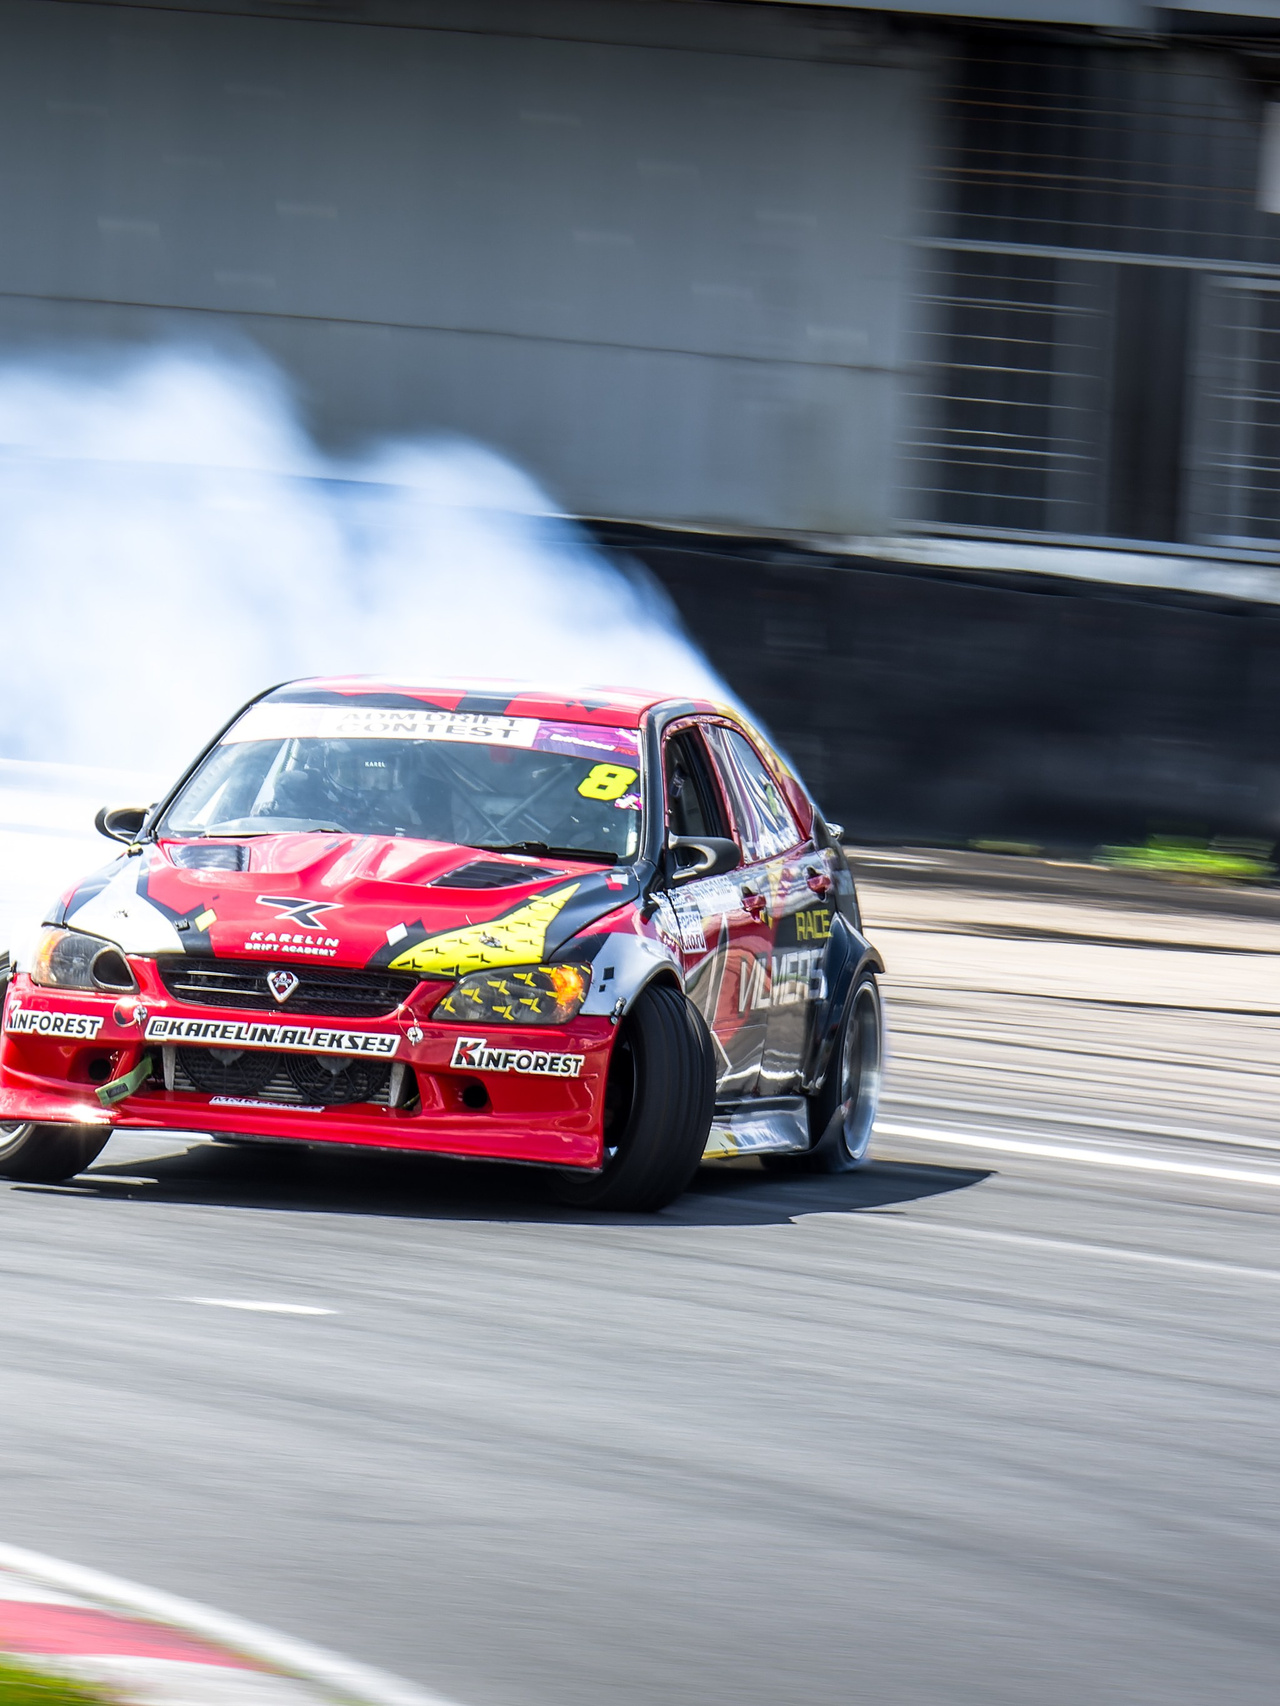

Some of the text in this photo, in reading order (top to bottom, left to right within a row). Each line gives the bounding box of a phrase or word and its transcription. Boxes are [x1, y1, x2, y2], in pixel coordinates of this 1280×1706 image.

[335, 722, 519, 739] CONTEST
[425, 713, 517, 728] DRIFT
[577, 764, 638, 801] 8
[250, 931, 339, 948] KARELIN
[795, 909, 832, 941] RACE
[244, 942, 337, 957] DRIFT ACADEMY
[6, 1004, 100, 1036] KINFOREST
[148, 1019, 398, 1053] @KARELIN.ALEKSEY
[454, 1041, 582, 1075] KINFOREST
